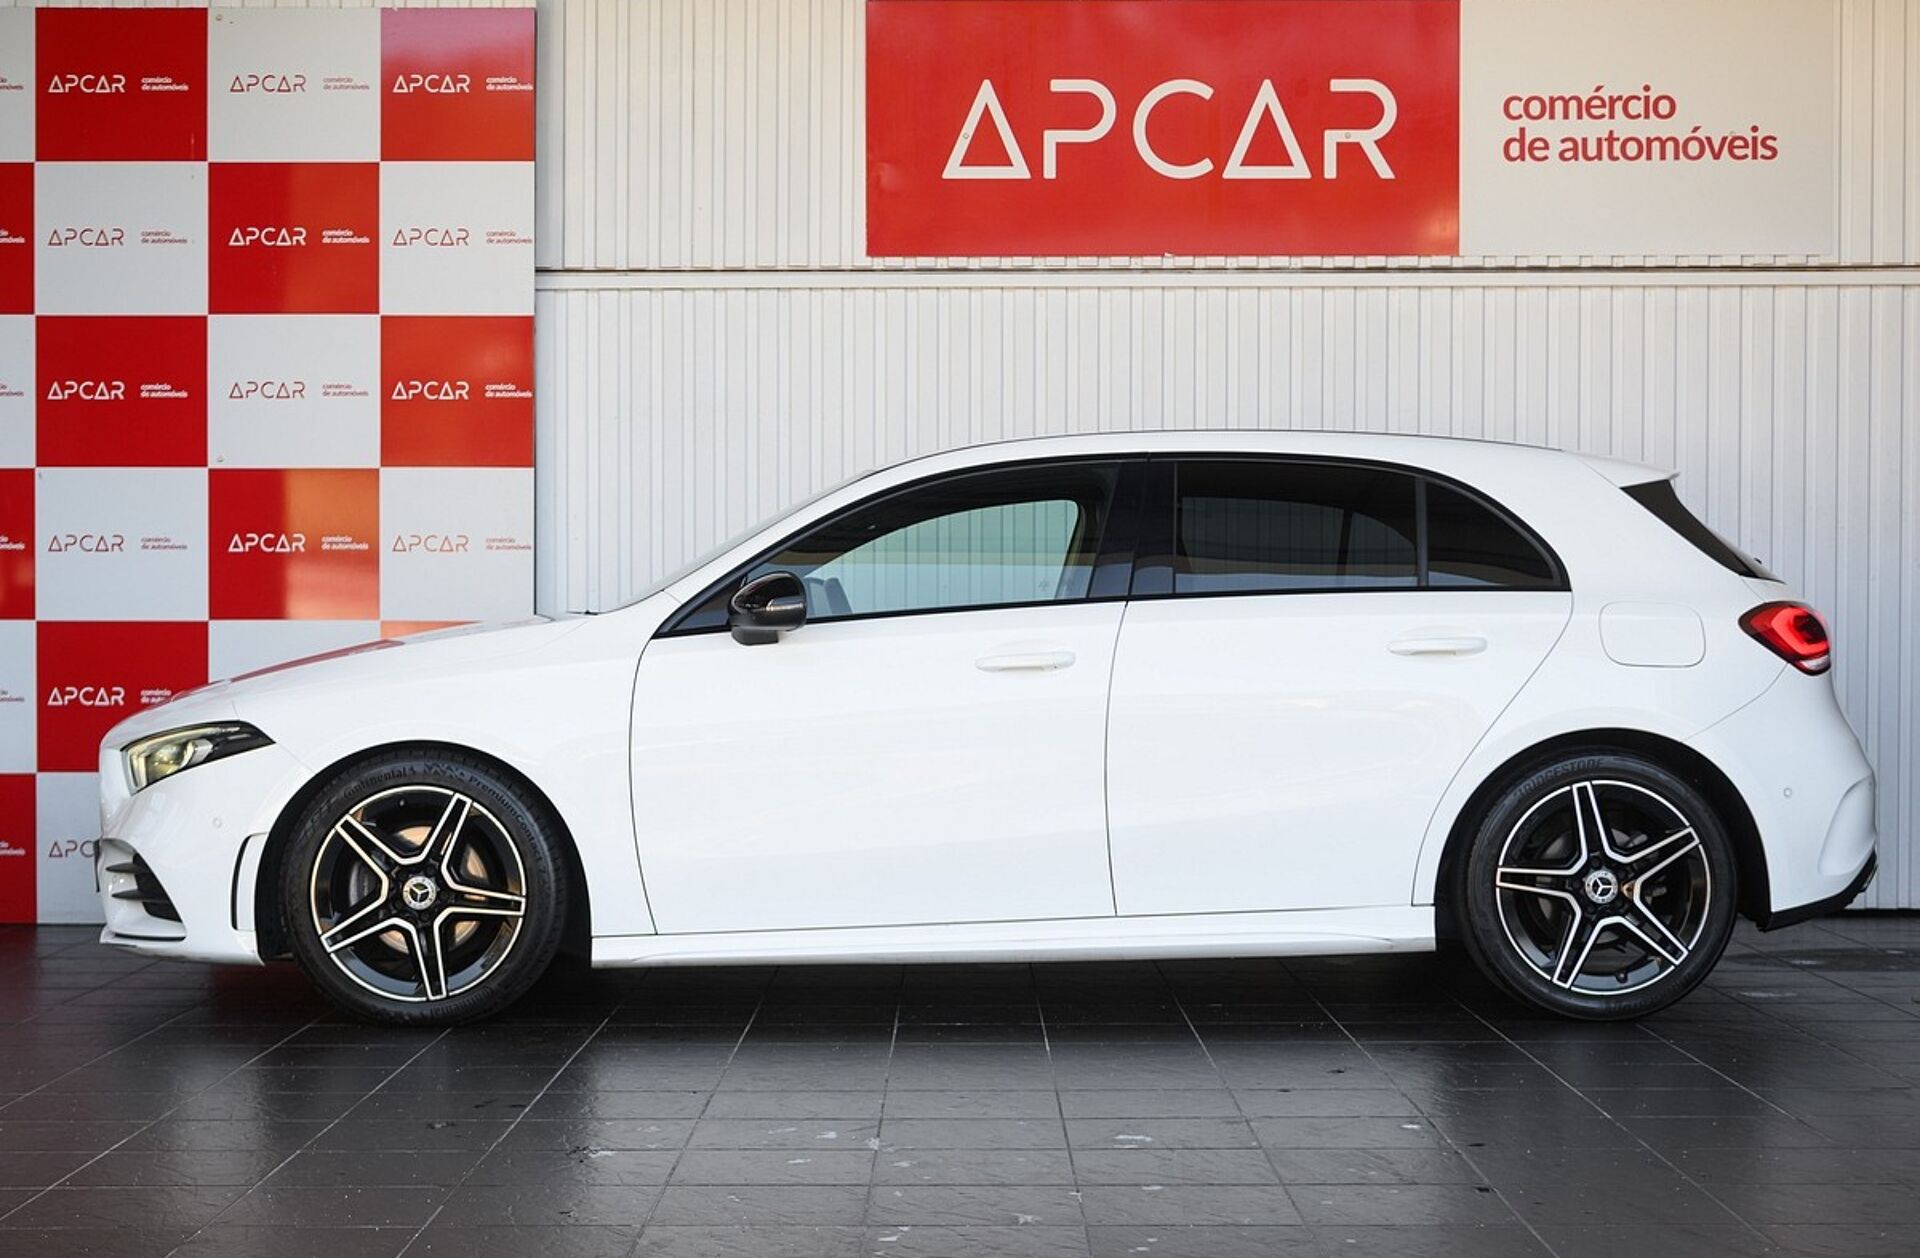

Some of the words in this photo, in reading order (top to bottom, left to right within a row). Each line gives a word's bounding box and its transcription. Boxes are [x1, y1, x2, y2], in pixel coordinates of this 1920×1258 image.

[48, 75, 125, 93] APCAR
[230, 75, 306, 93] APCAR
[393, 75, 470, 93] APCAR
[1502, 84, 1677, 121] comércio
[942, 79, 1398, 180] APCAR
[1502, 126, 1551, 162] de
[1558, 125, 1778, 162] automóveis
[48, 228, 124, 246] APCAR
[229, 227, 306, 246] APCAR
[393, 228, 469, 246] APCAR
[48, 381, 125, 400] APCAR
[229, 382, 305, 399] APCAR
[392, 381, 470, 400] APCAR
[48, 535, 124, 552] APCAR
[229, 533, 306, 552] APCAR
[392, 535, 469, 552] APCAR
[48, 687, 125, 706] APCAR
[48, 840, 94, 858] APC
